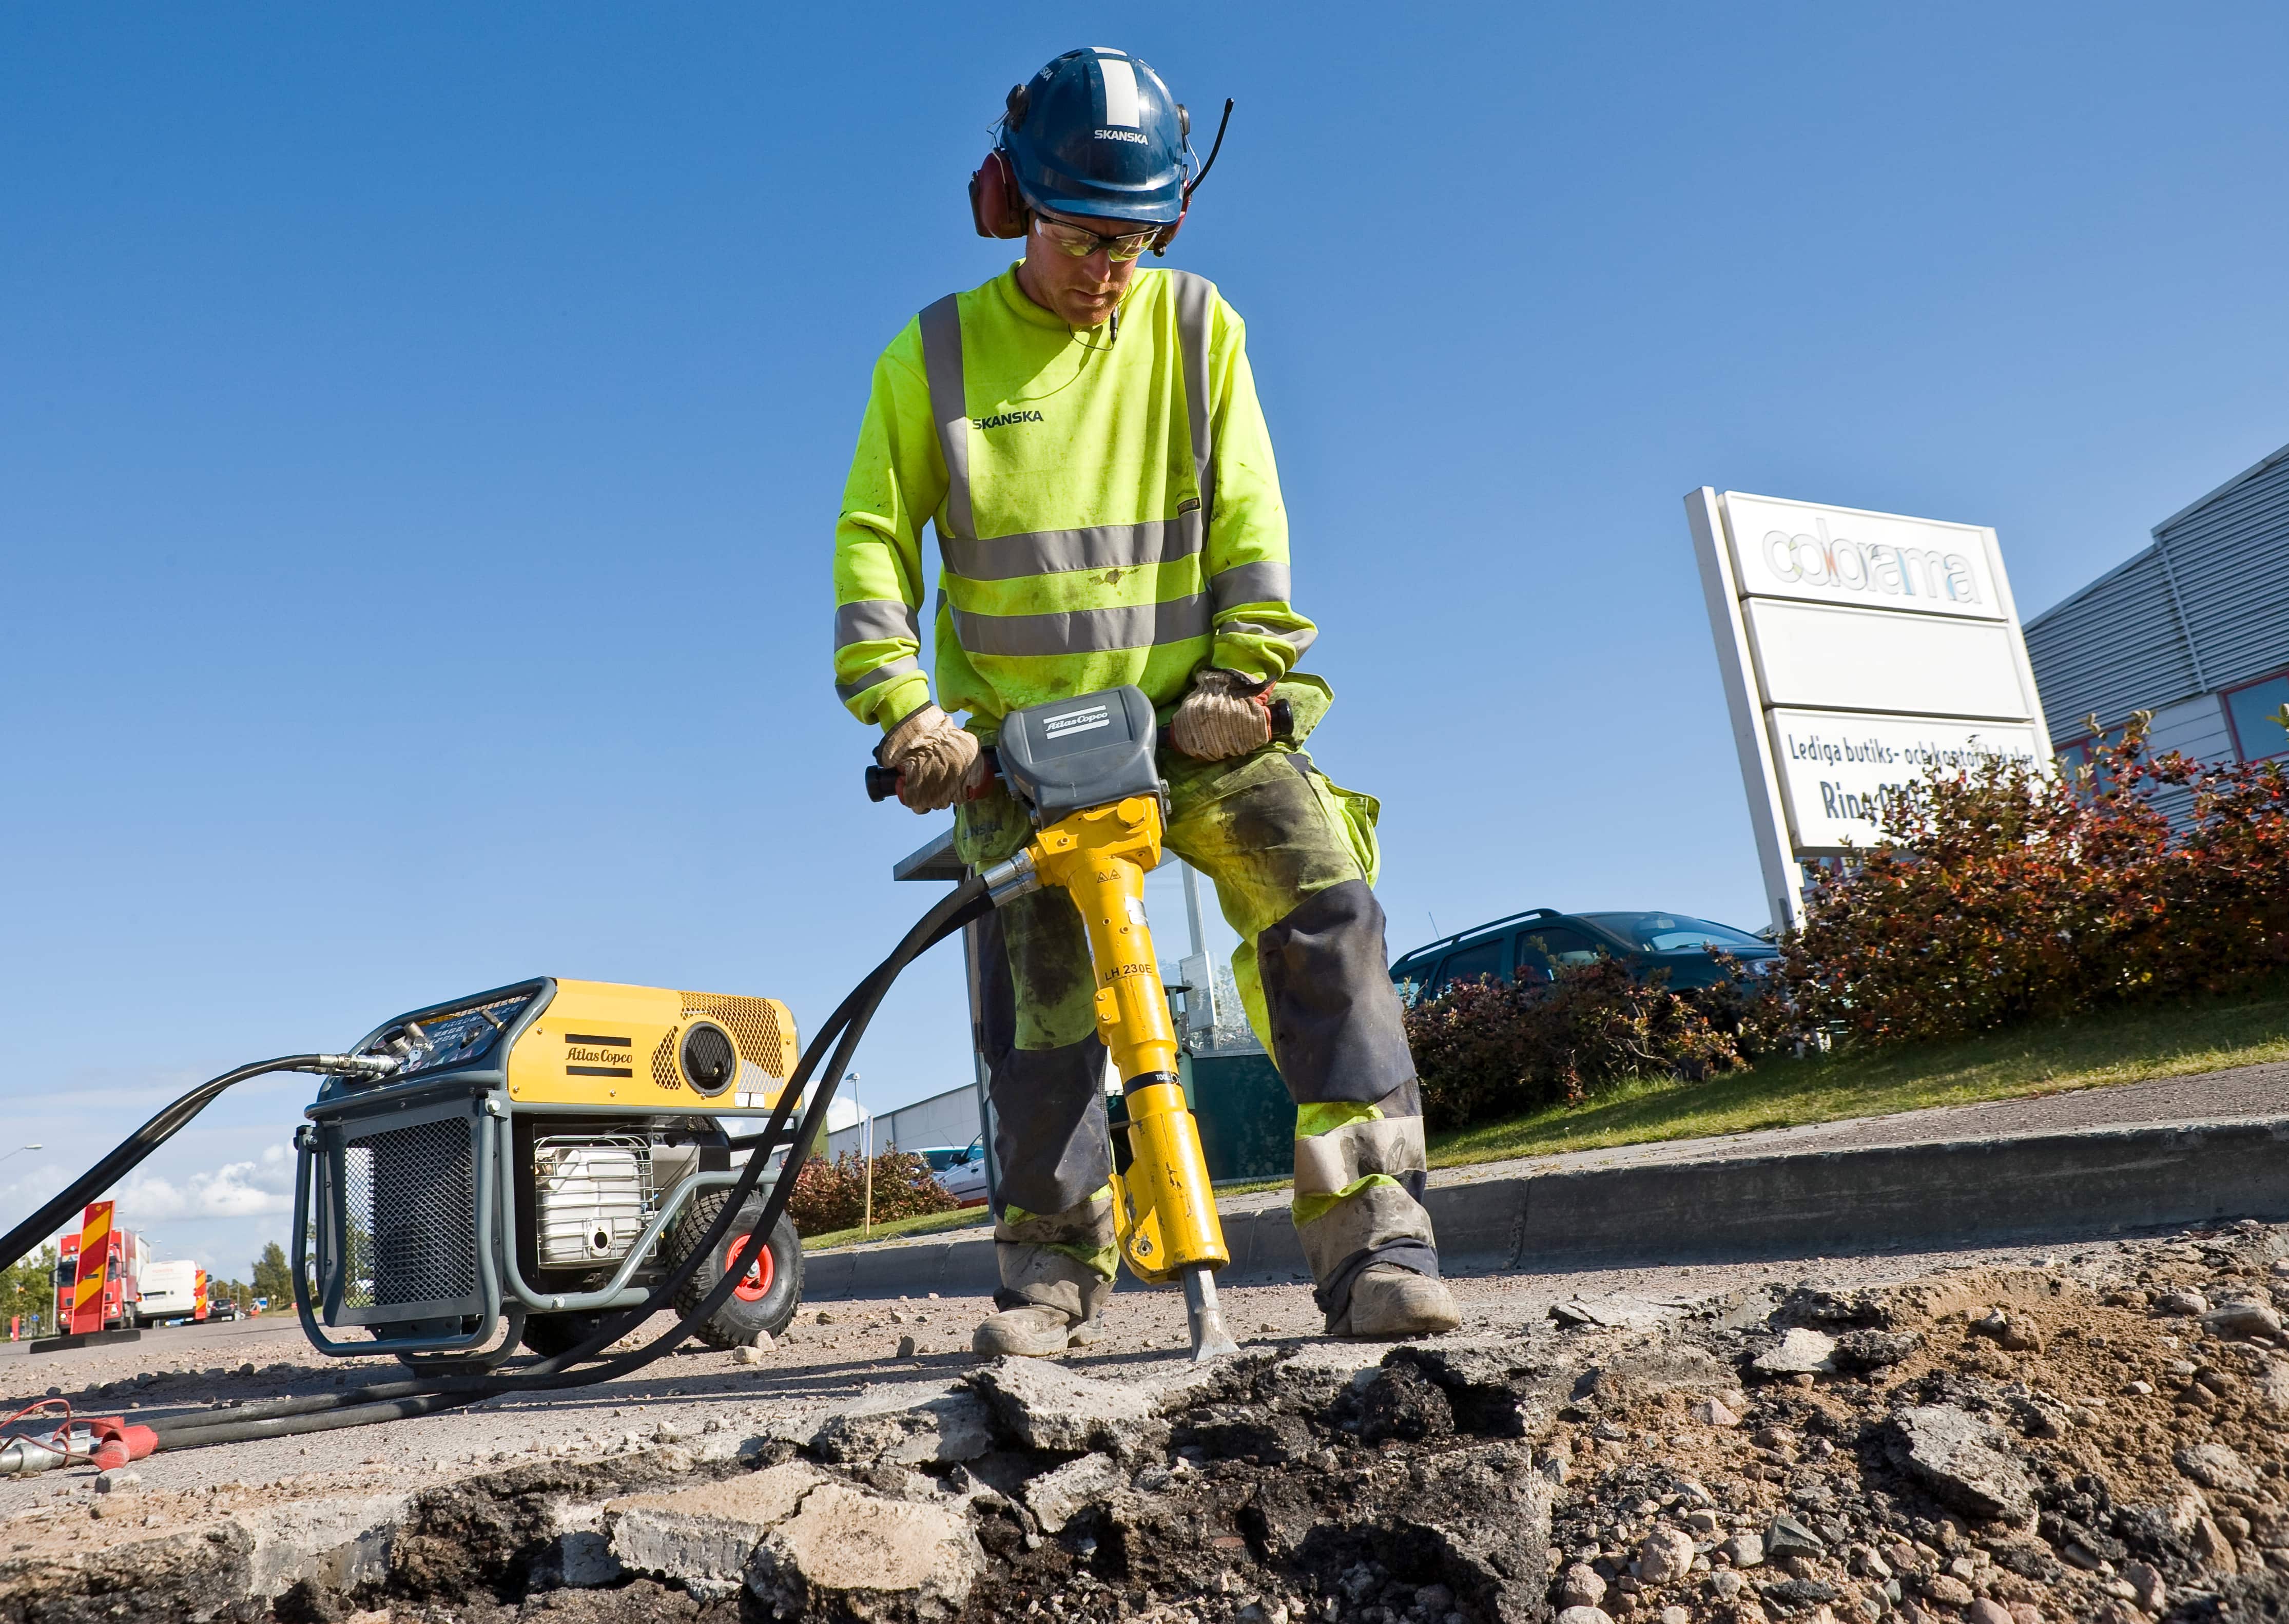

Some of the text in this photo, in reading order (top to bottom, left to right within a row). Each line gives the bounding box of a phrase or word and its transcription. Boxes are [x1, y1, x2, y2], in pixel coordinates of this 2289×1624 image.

[1094, 129, 1149, 145] SKANSKA
[973, 411, 1044, 430] SKANSKA
[1762, 517, 1983, 604] colorama
[1045, 712, 1108, 731] Atlas Copco
[1788, 733, 1842, 766] Lediga
[1843, 737, 1900, 764] butiks-
[1104, 964, 1152, 981] LH 230E
[565, 1047, 633, 1065] Atlas Copco
